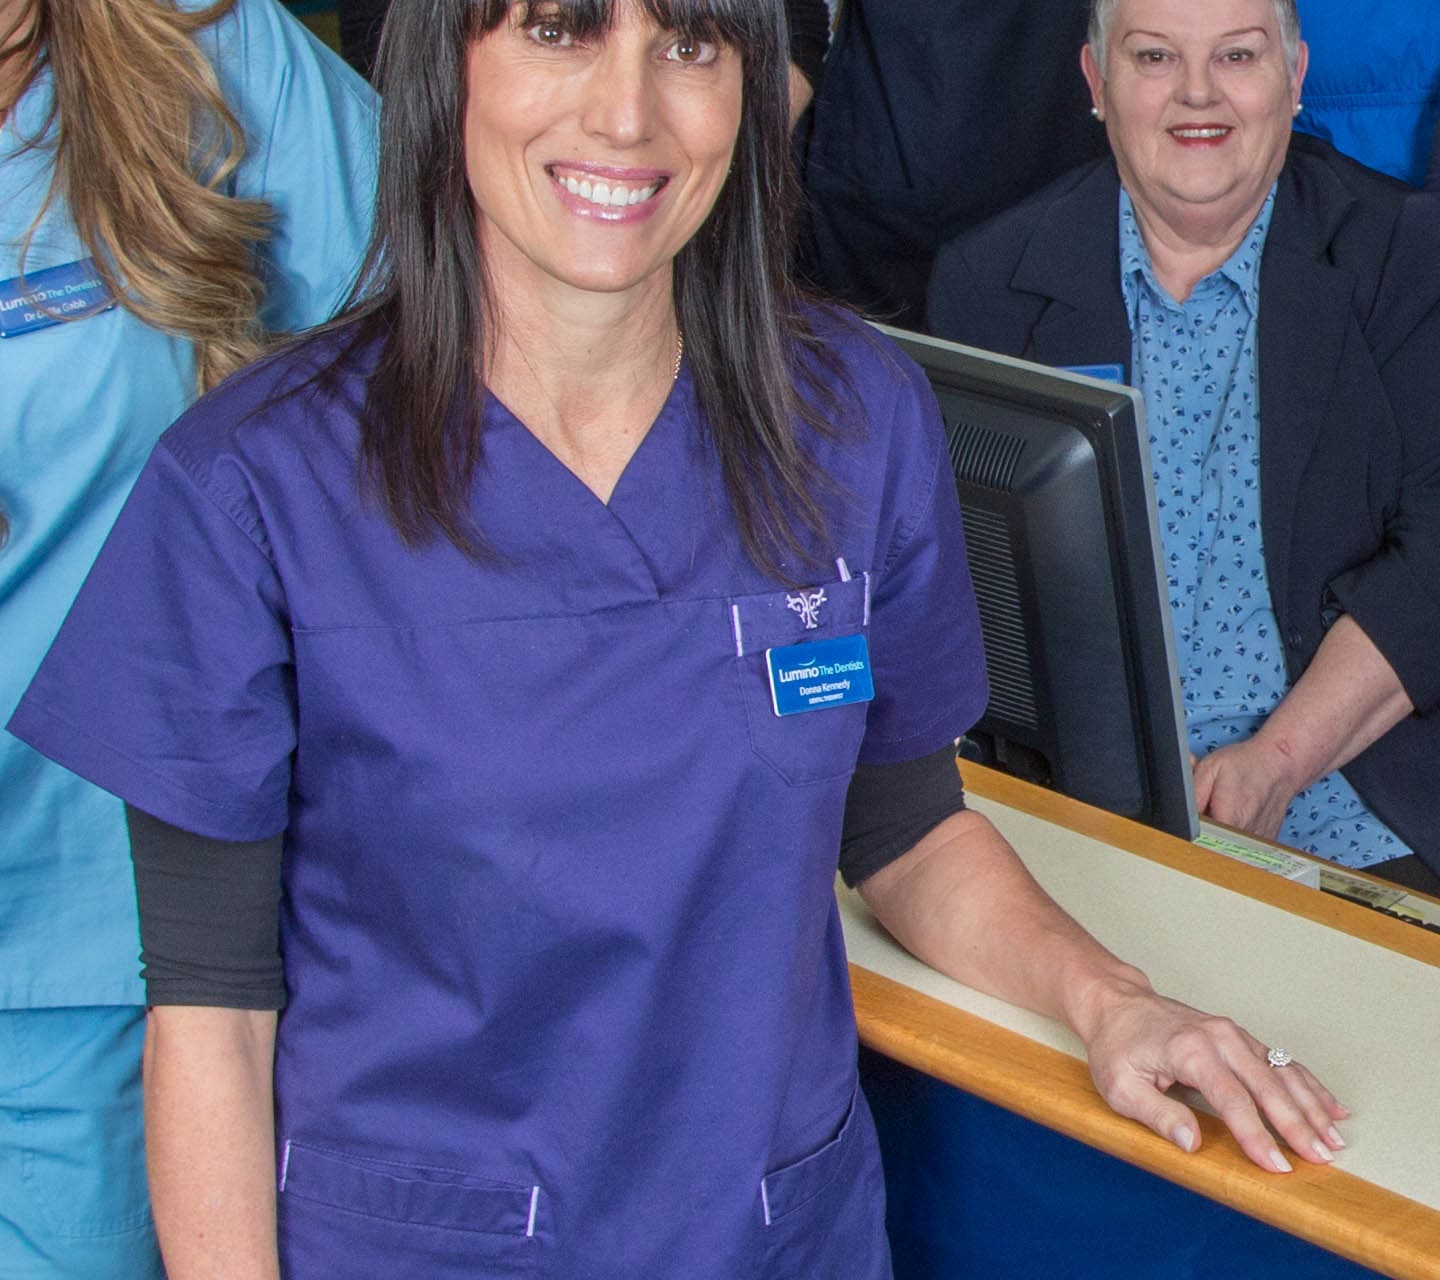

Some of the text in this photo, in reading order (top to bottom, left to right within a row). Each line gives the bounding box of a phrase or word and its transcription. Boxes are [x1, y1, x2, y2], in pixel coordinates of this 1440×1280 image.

[47, 289, 64, 298] The
[62, 300, 87, 312] Gabb
[779, 660, 864, 683] Lumino The Dentists
[822, 678, 851, 692] Kennedy
